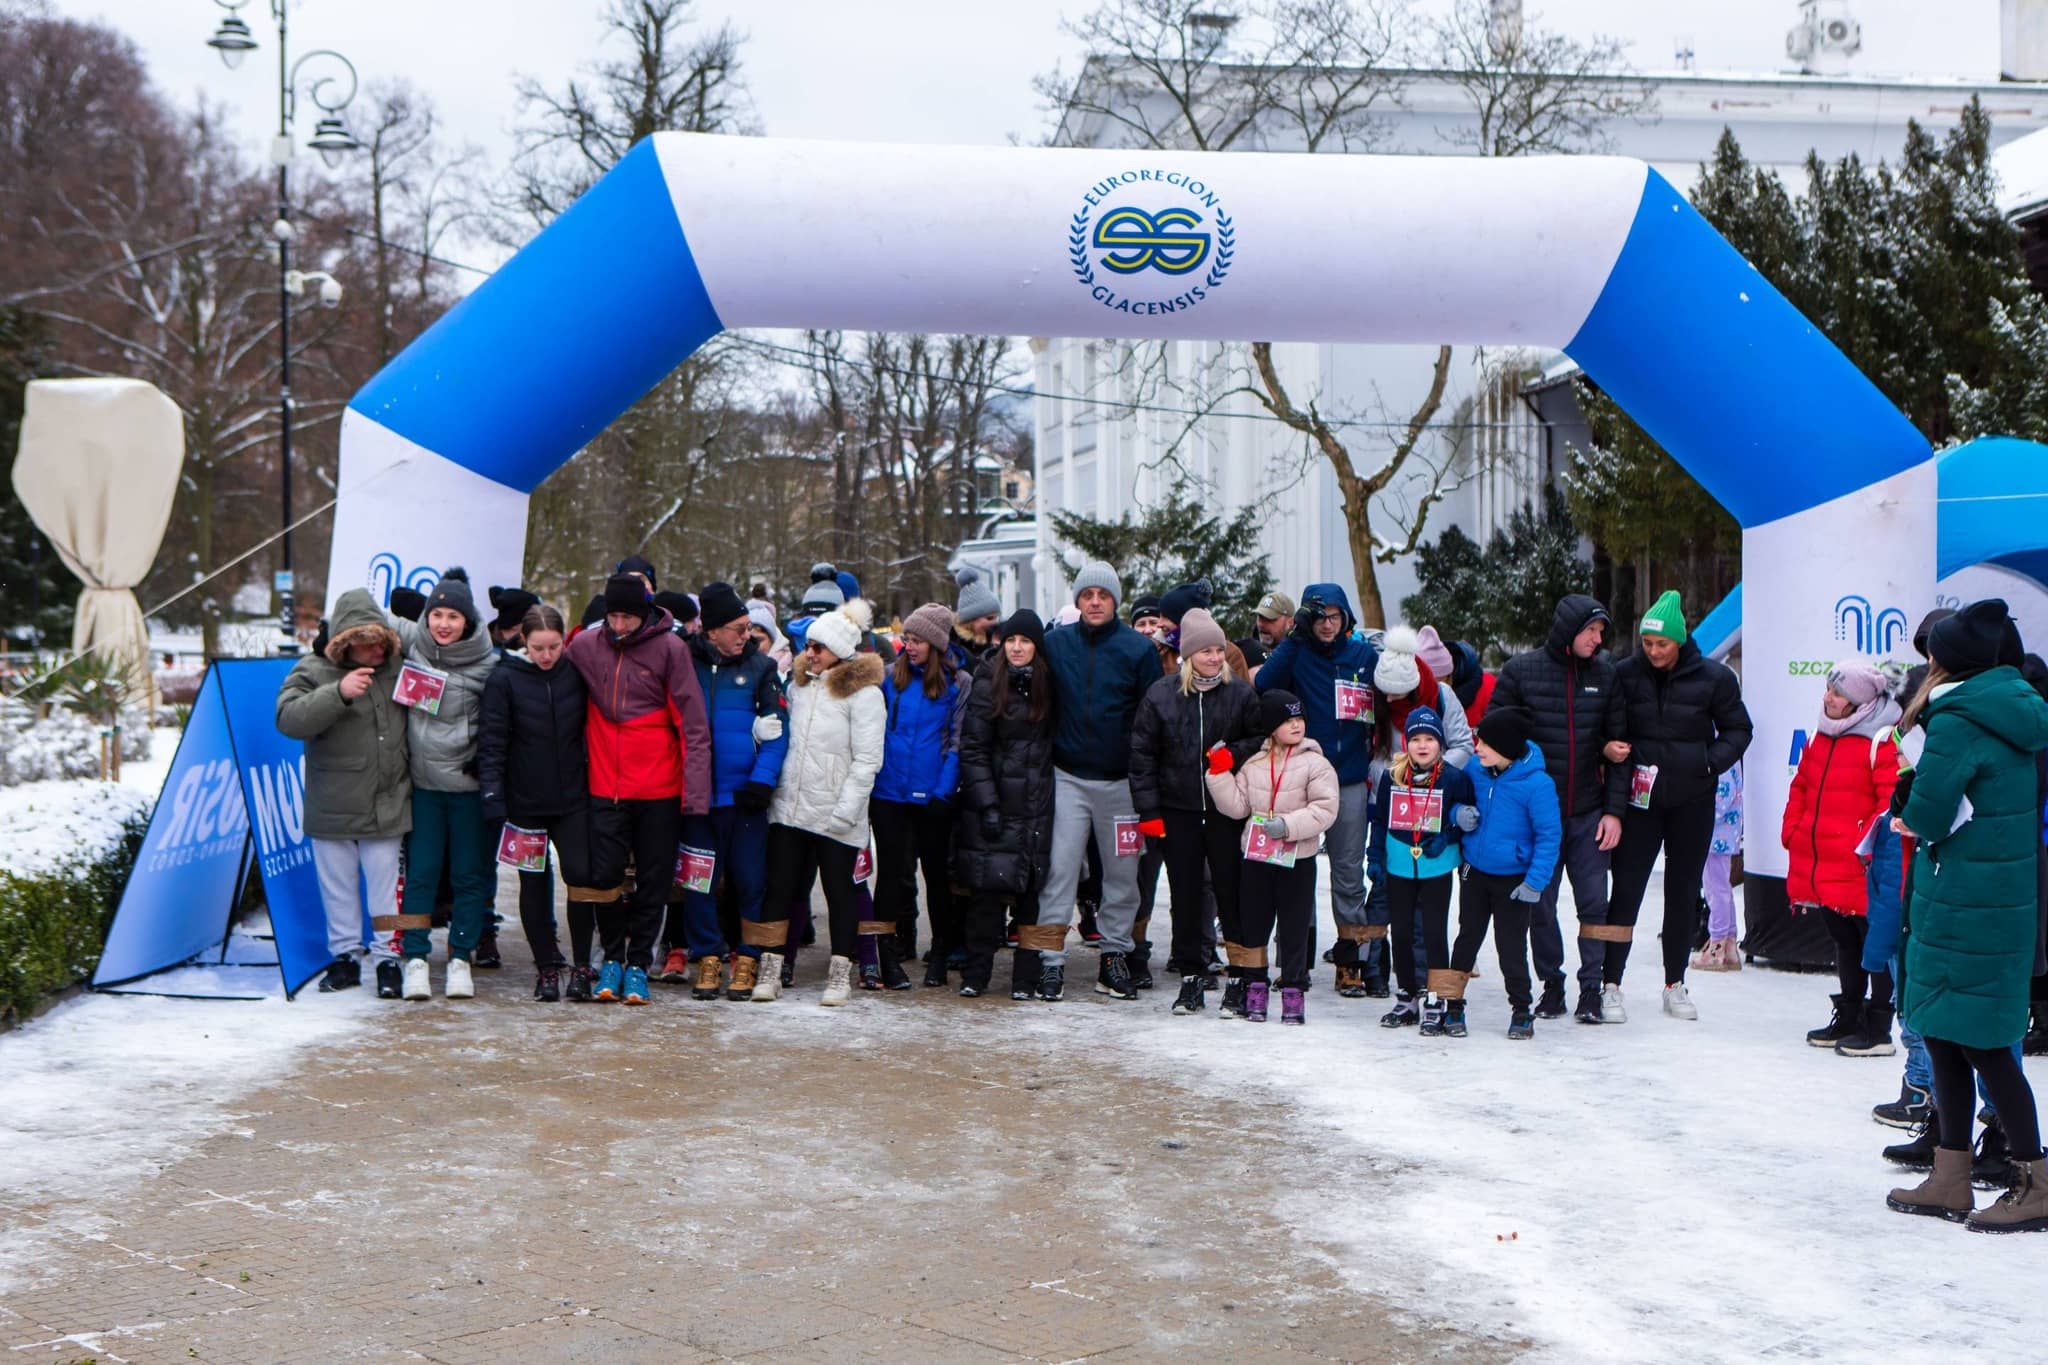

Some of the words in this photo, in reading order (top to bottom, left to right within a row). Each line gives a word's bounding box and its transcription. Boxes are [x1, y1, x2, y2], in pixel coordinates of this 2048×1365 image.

[1083, 169, 1220, 208] EUROREGION
[1091, 285, 1206, 315] GLACENSIS
[408, 678, 417, 692] 7
[1341, 694, 1355, 708] 11
[1399, 802, 1409, 816] 9
[1120, 831, 1137, 843] 19
[1257, 834, 1267, 847] 3
[507, 840, 516, 852] 6
[265, 846, 313, 878] SZCZAWN
